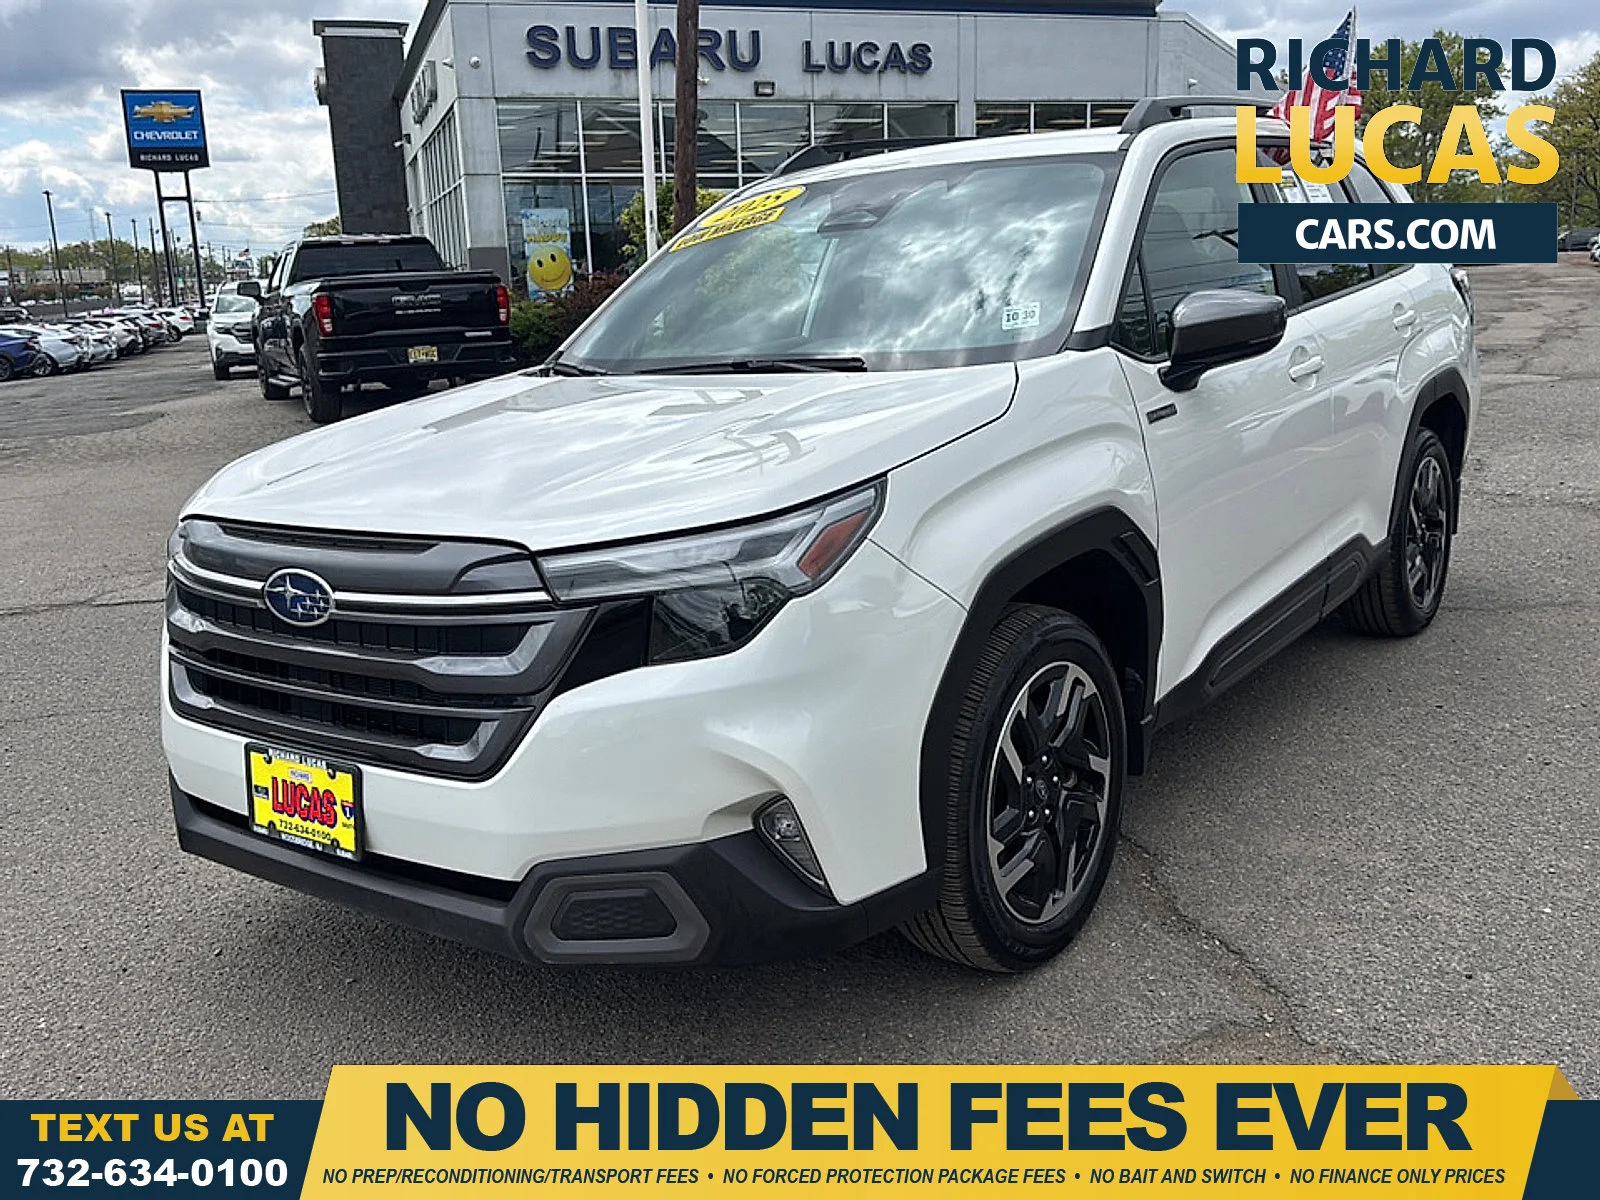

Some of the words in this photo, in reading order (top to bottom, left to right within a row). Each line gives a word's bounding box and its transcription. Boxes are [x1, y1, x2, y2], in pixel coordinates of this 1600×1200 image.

[526, 25, 761, 72] SUBARU
[802, 39, 933, 74] LUCAS
[133, 130, 199, 140] CHEVROLET
[140, 153, 172, 161] RICHARD
[174, 153, 200, 161] LUCAS
[272, 776, 338, 828] LUCAS
